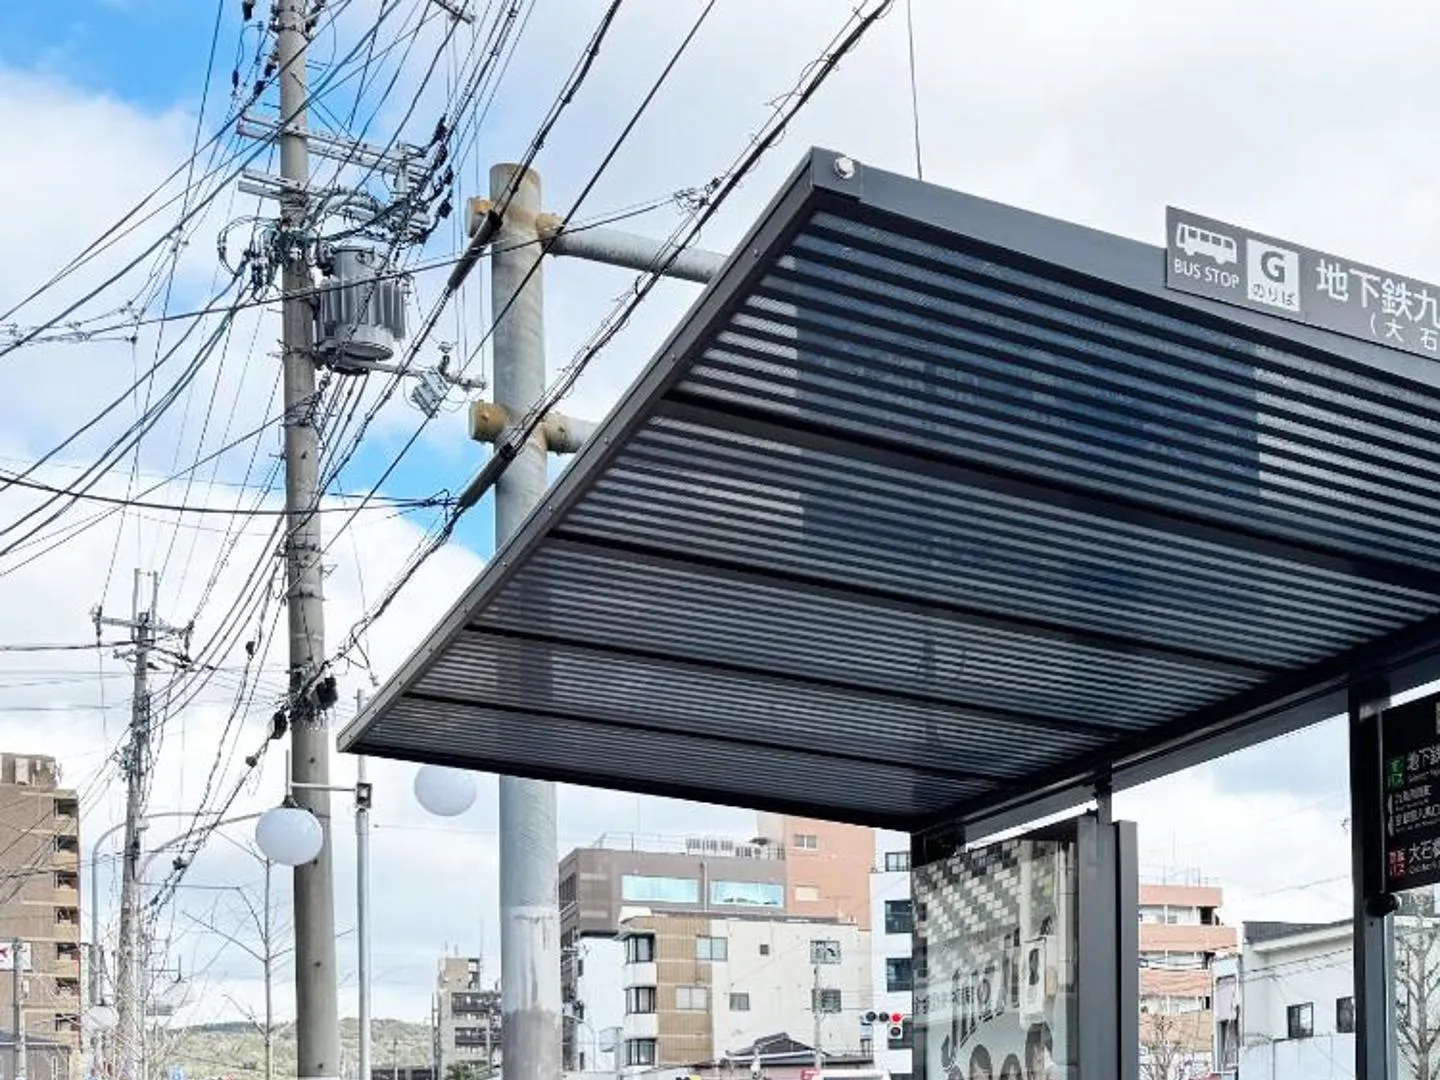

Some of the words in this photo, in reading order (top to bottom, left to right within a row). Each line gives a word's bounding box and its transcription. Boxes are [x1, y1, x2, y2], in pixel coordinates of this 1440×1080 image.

[1174, 258, 1201, 280] BUS
[1205, 266, 1239, 289] STOP
[1261, 251, 1285, 283] G
